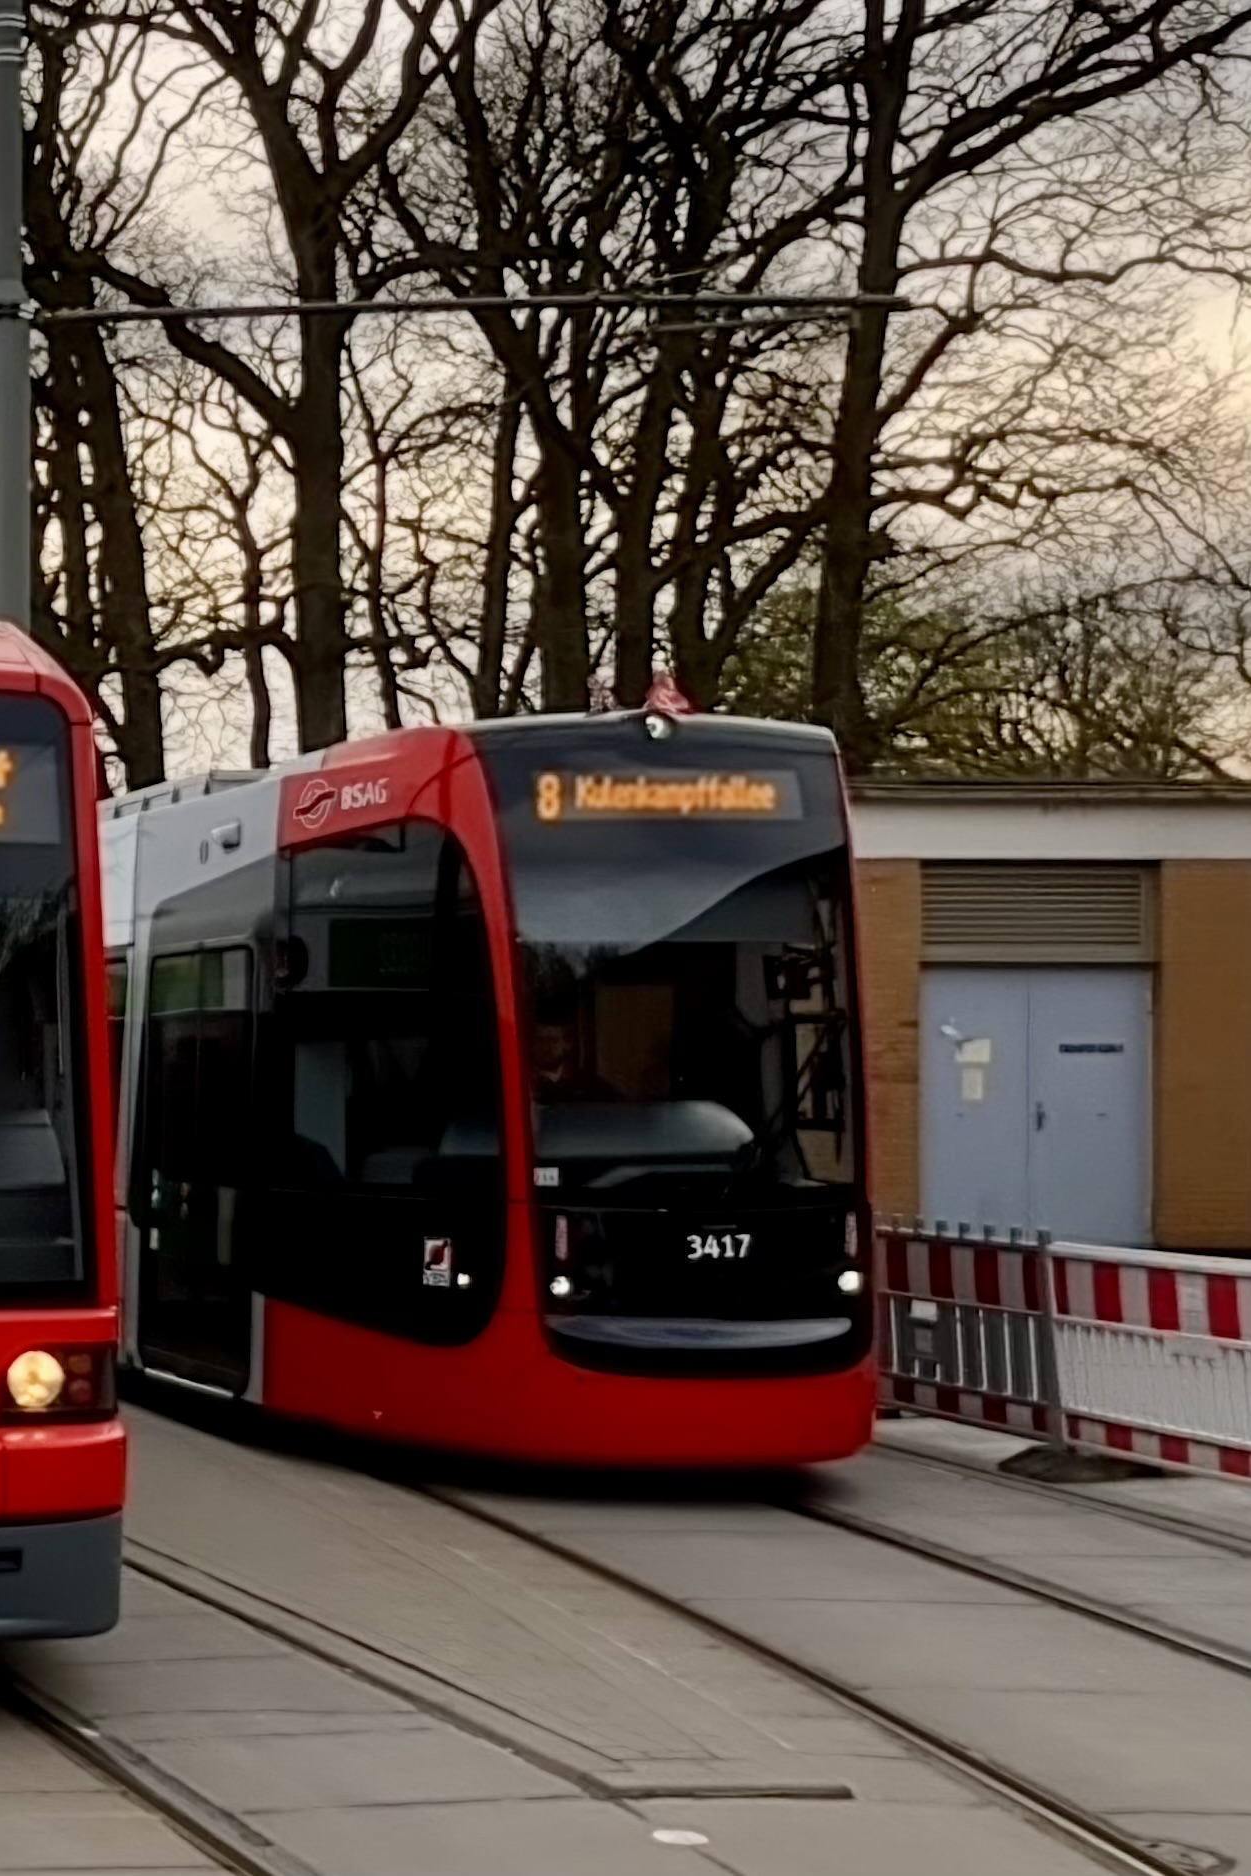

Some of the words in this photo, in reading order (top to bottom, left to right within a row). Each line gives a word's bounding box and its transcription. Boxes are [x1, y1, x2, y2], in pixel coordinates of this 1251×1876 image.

[341, 777, 390, 811] BSAG
[537, 773, 561, 820] 8
[686, 1233, 751, 1260] 3417
